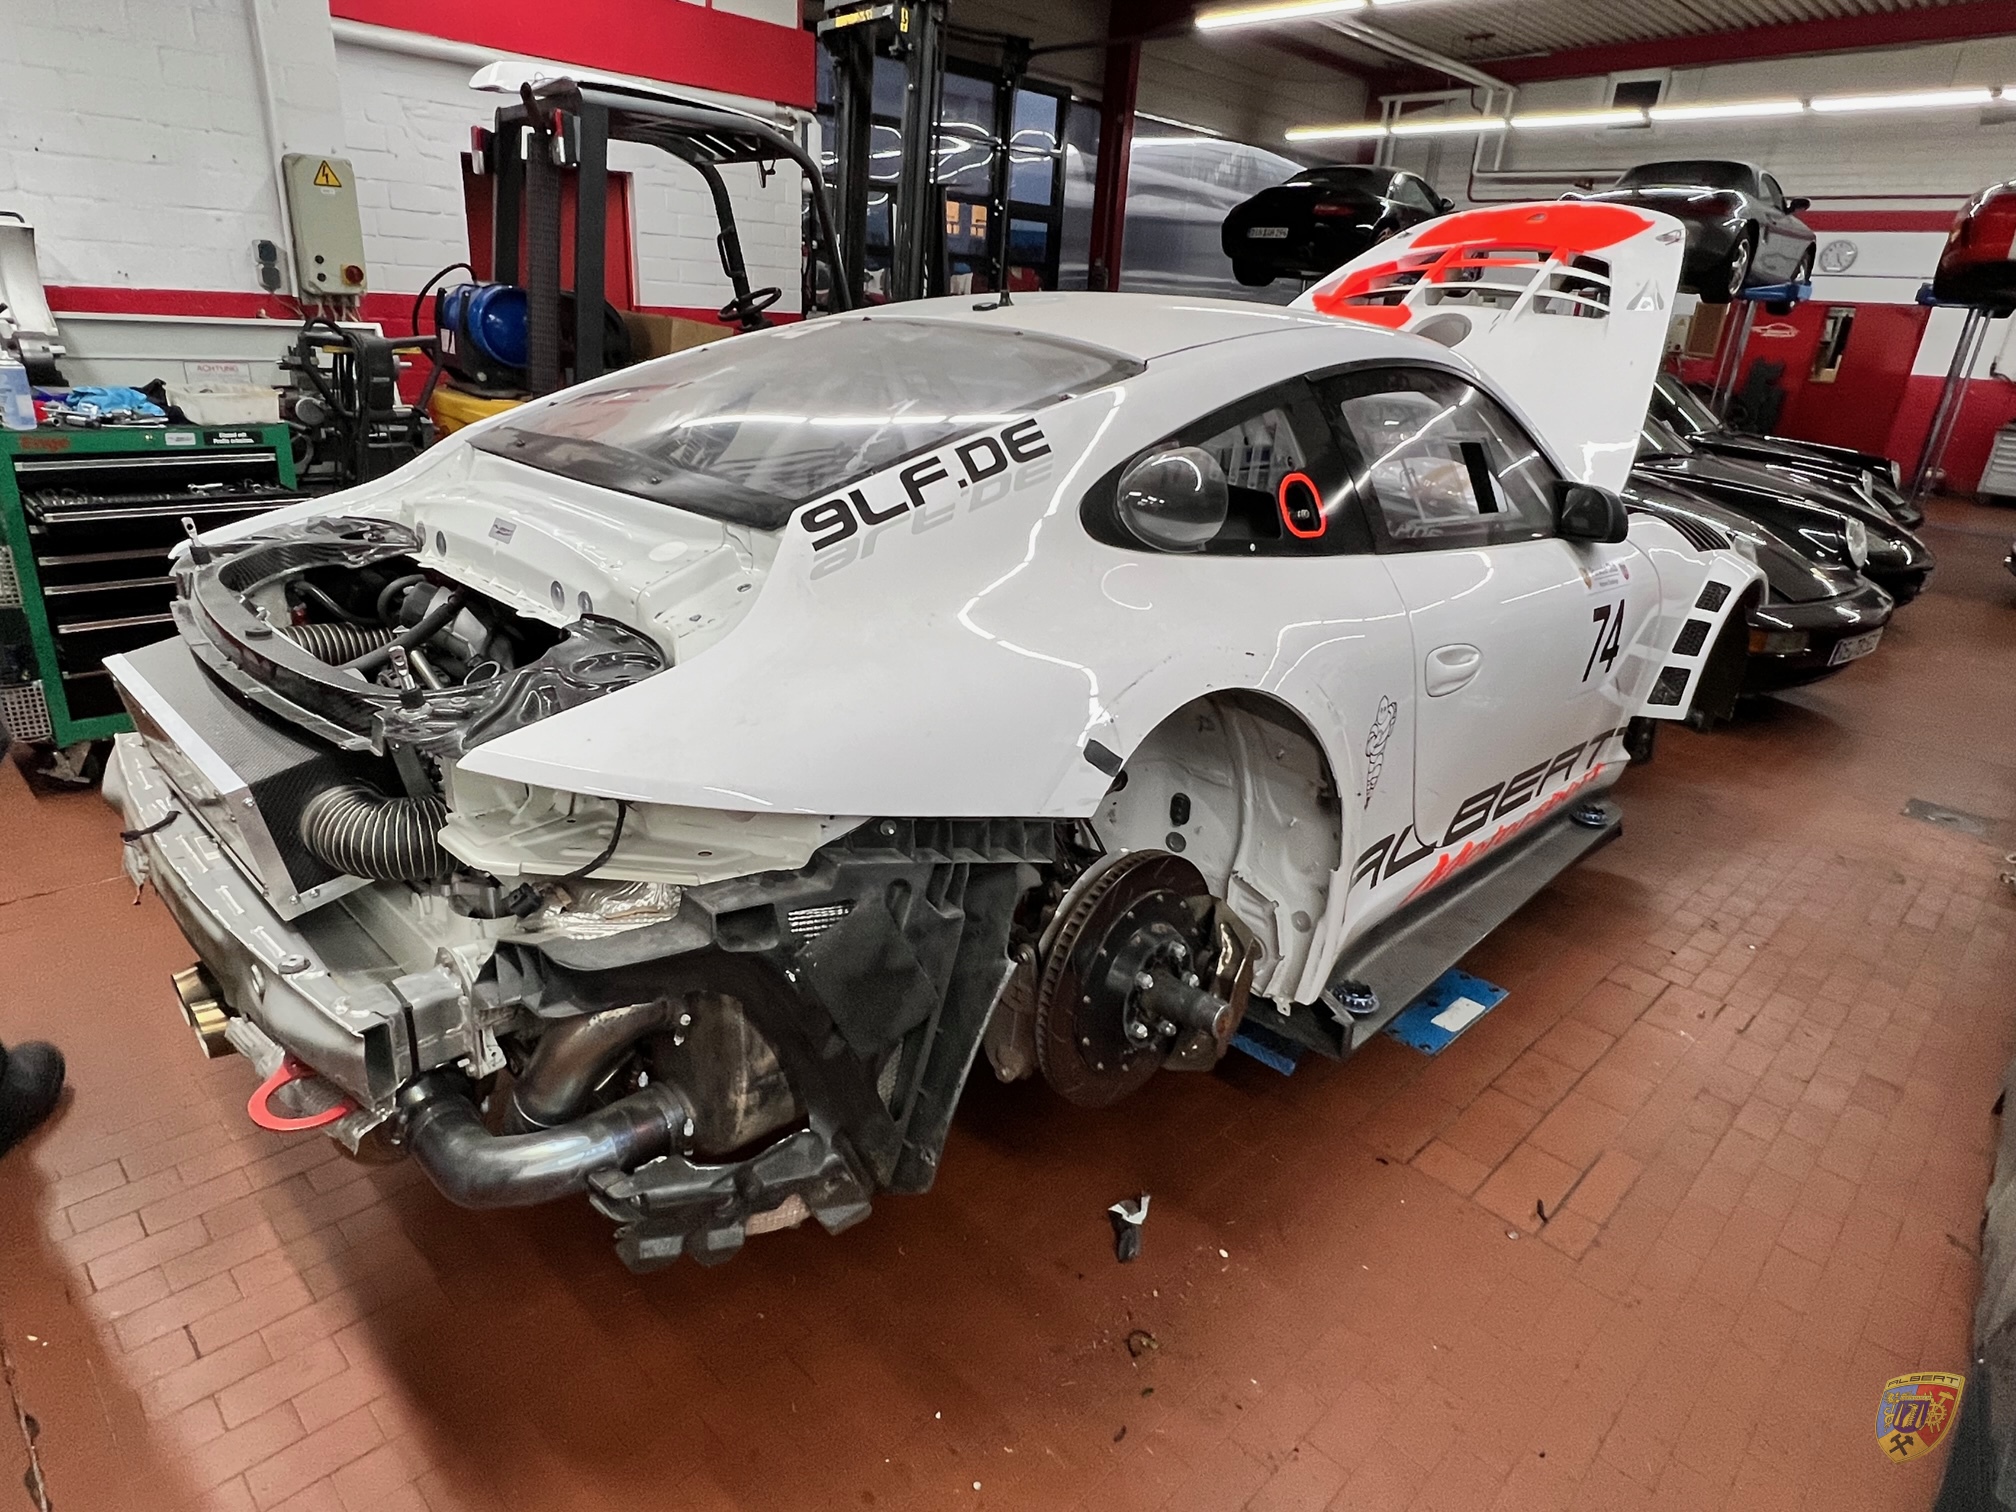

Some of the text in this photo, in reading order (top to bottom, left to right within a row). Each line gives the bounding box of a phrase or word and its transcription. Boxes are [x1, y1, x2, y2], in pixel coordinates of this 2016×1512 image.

[800, 418, 1052, 552] 9LF.DE
[1582, 598, 1625, 683] 74
[1349, 726, 1629, 890] ALBERT
